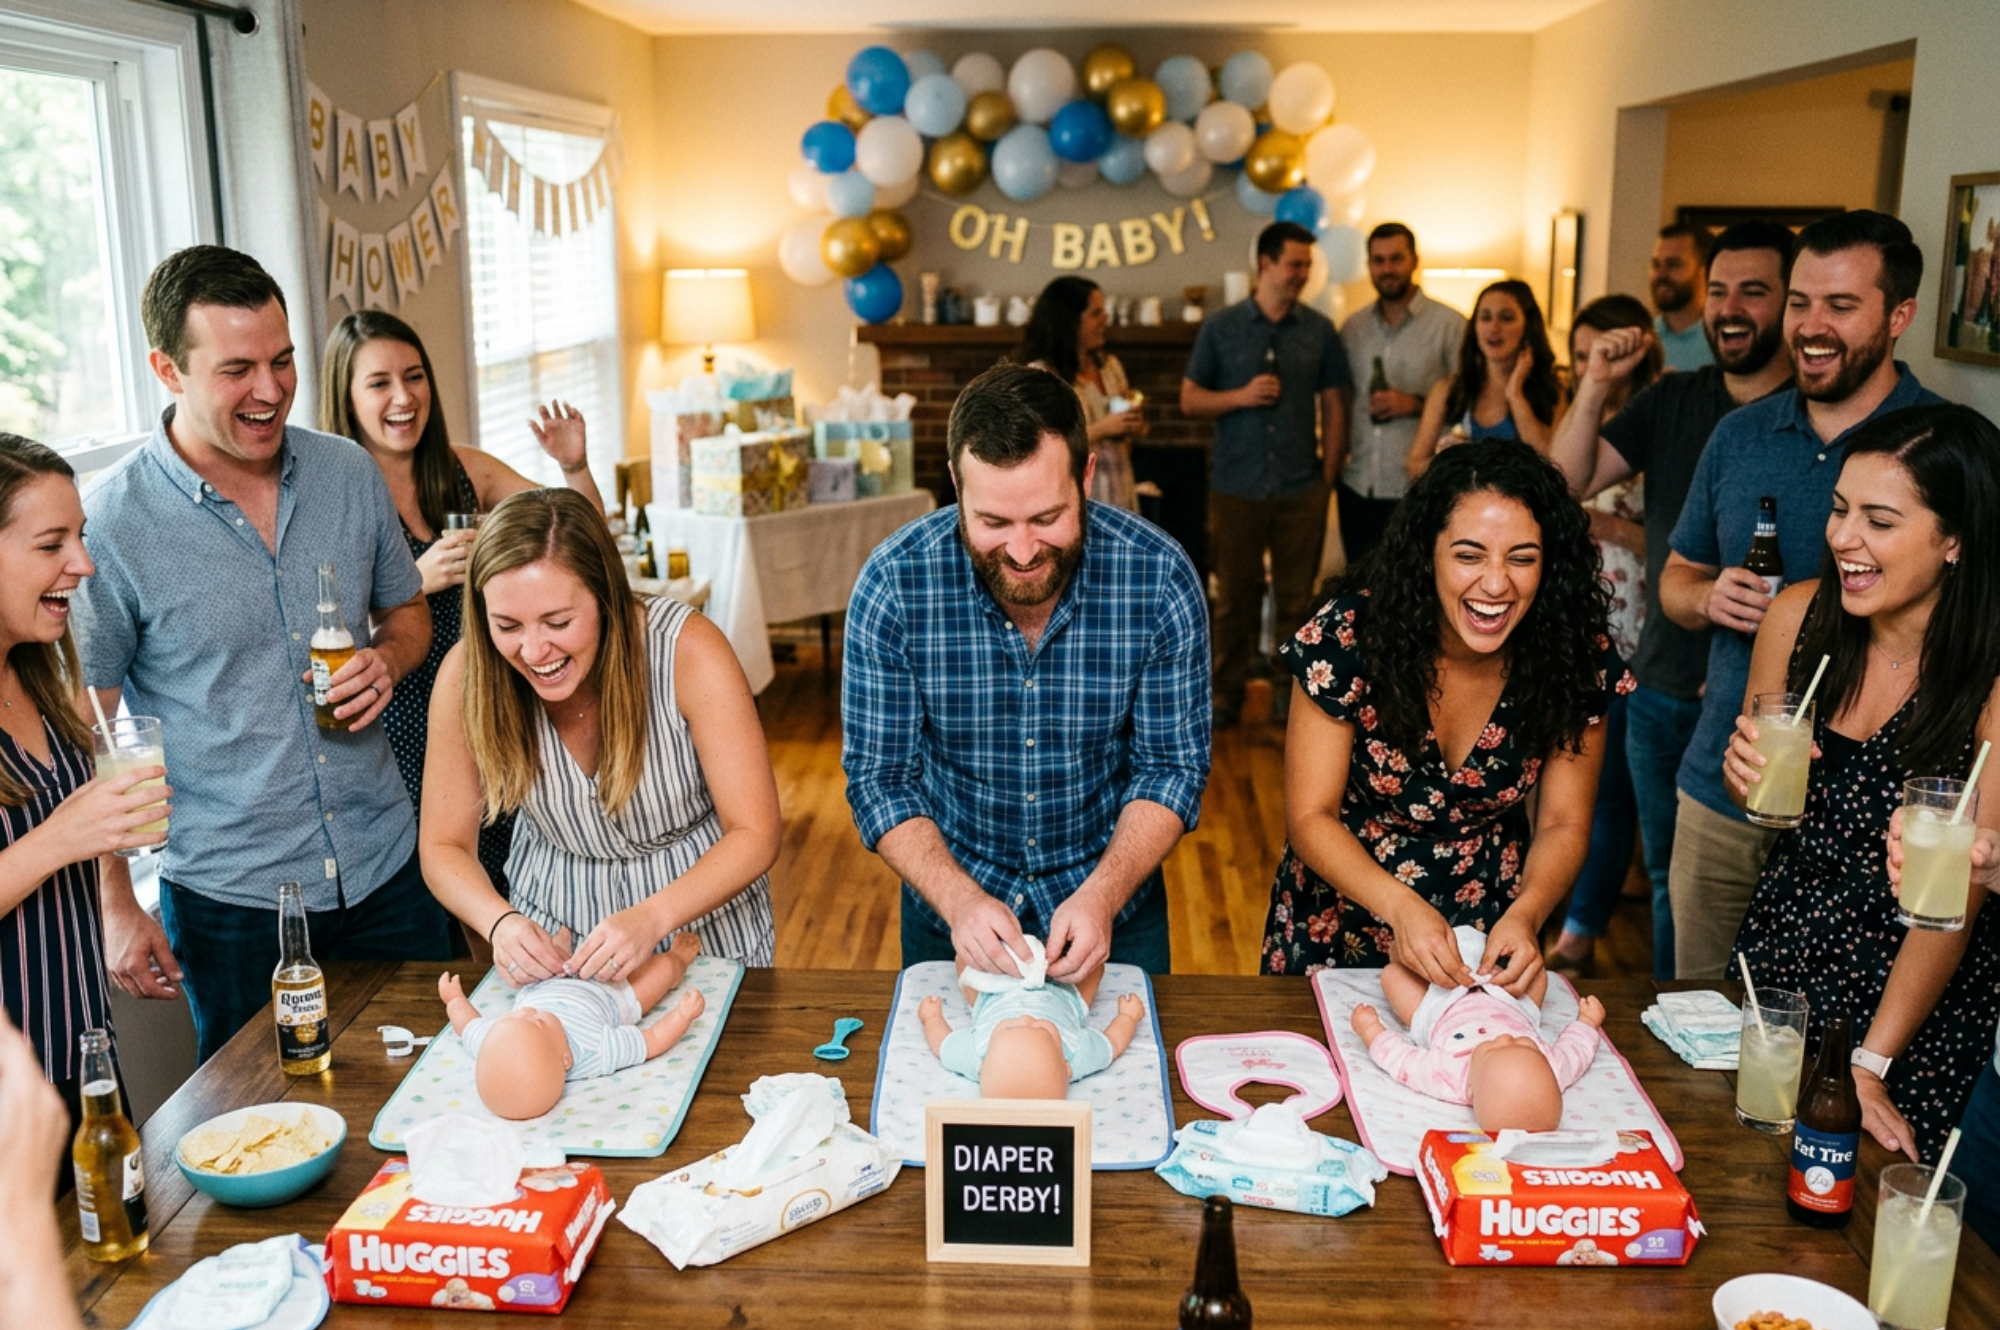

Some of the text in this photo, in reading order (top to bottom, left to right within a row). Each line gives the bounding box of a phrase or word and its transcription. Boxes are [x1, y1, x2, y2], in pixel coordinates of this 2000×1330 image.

[310, 98, 418, 179] BABY
[335, 185, 457, 293] HOWER
[949, 198, 1216, 269] OH BABY!
[954, 1145, 1054, 1173] DIAPER
[1794, 1135, 1816, 1159] Fat
[963, 1184, 1061, 1215] DERBY!
[1480, 1199, 1641, 1237] HUGGIES
[348, 1234, 510, 1279] HUGGIES
